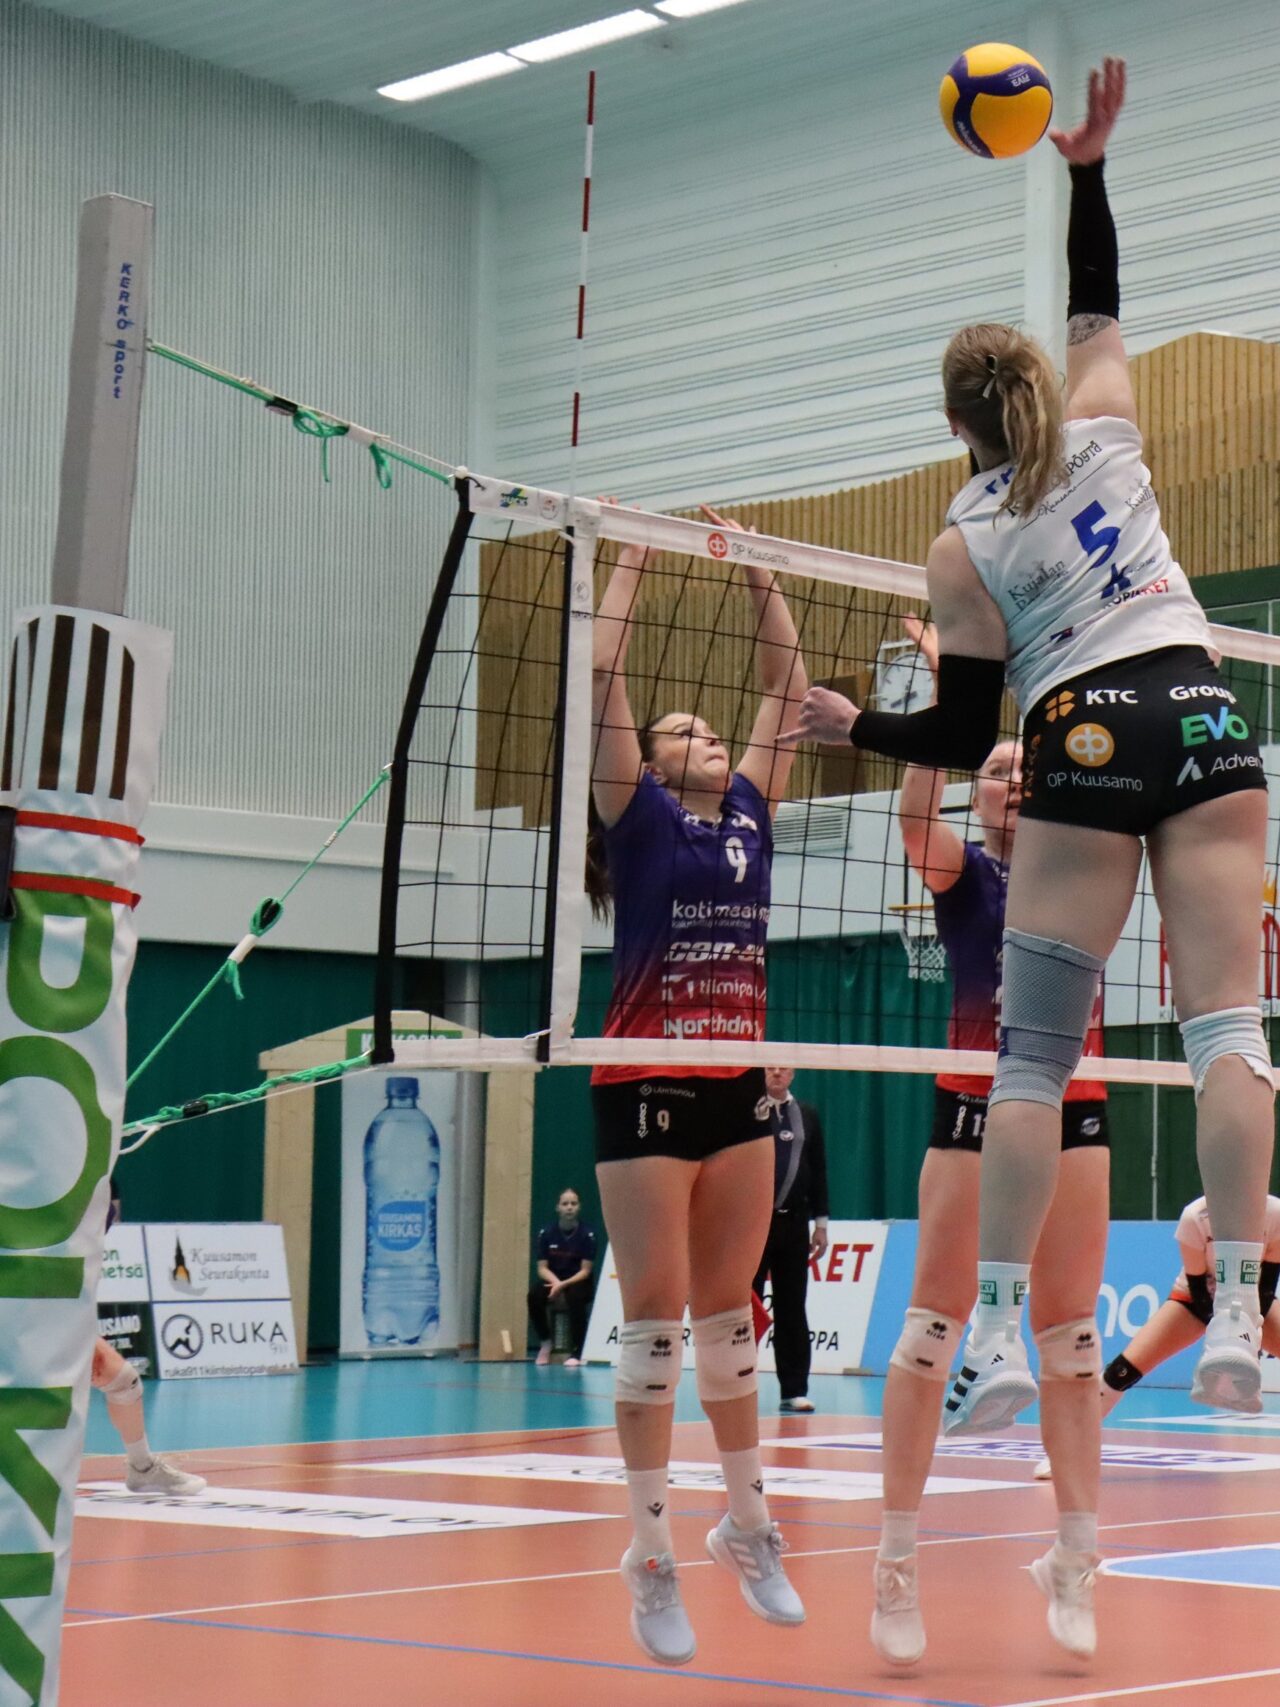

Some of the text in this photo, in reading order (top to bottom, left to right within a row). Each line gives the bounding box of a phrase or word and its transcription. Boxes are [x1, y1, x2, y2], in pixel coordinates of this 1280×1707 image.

[117, 262, 132, 330] KERKO
[1070, 500, 1121, 569] 5
[1086, 685, 1237, 705] KTC Group
[1181, 706, 1249, 747] EVO
[1047, 771, 1143, 792] OP Kuusamo
[725, 837, 748, 884] 9
[657, 1109, 670, 1132] 9
[378, 1223, 422, 1238] KIRKAS
[199, 1264, 270, 1283] Seurakunta
[209, 1321, 289, 1345] RUKA
